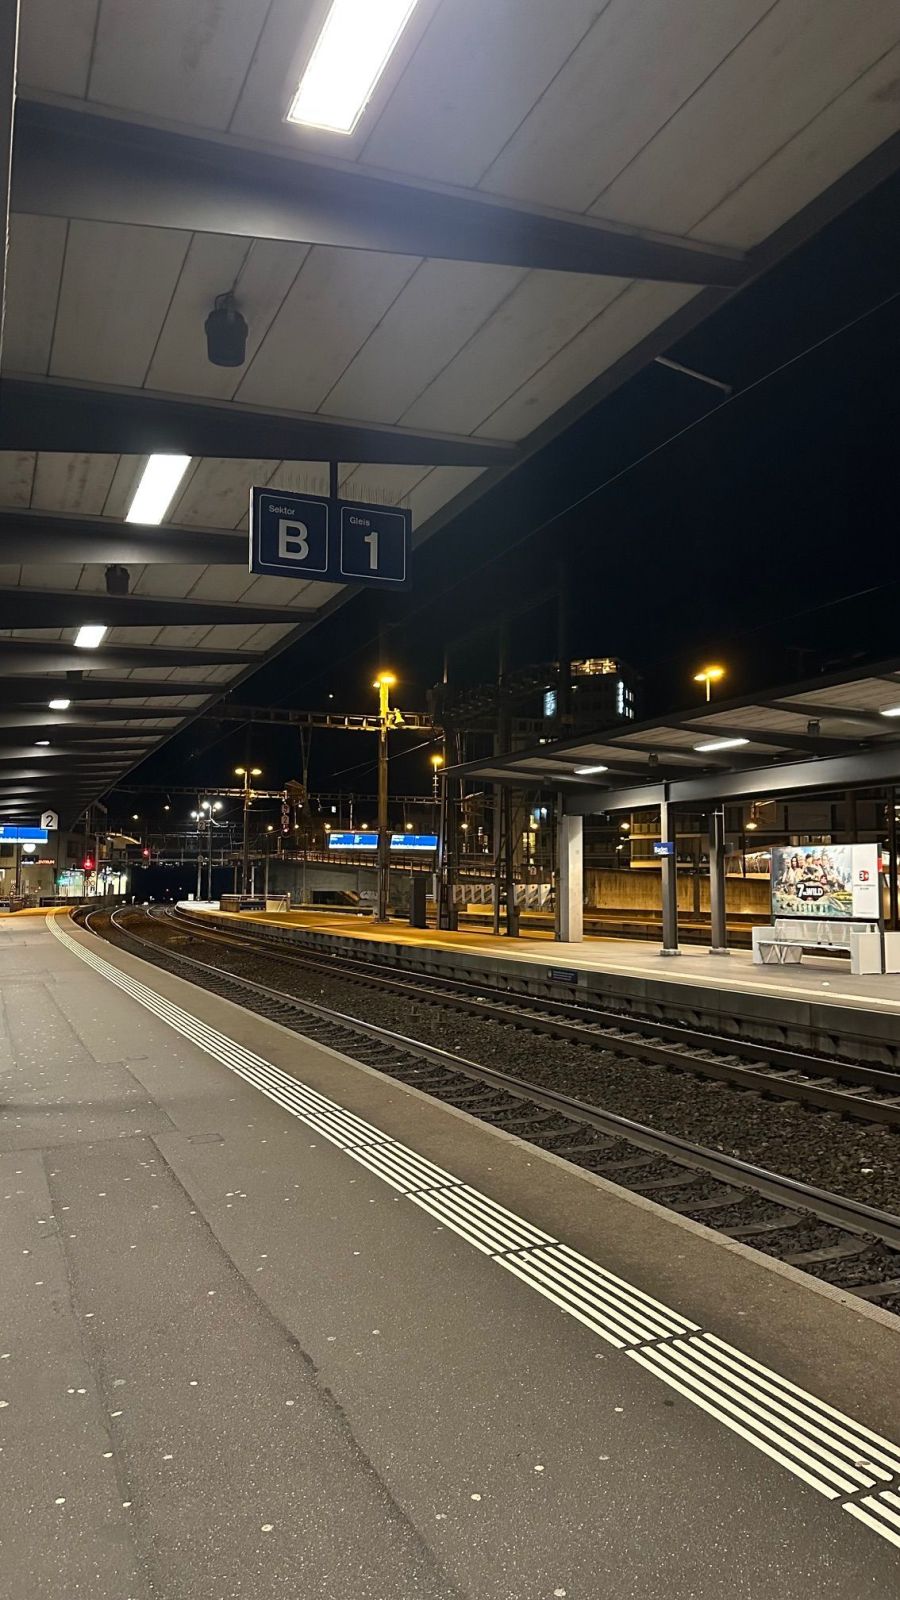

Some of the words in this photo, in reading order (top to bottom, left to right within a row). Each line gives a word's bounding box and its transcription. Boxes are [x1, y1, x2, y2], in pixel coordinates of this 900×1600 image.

[268, 504, 295, 516] Sektor
[349, 516, 370, 527] Gleis
[278, 519, 309, 560] B
[364, 531, 378, 570] 1
[45, 815, 54, 828] 2
[797, 883, 805, 897] 7
[806, 887, 824, 896] WILD
